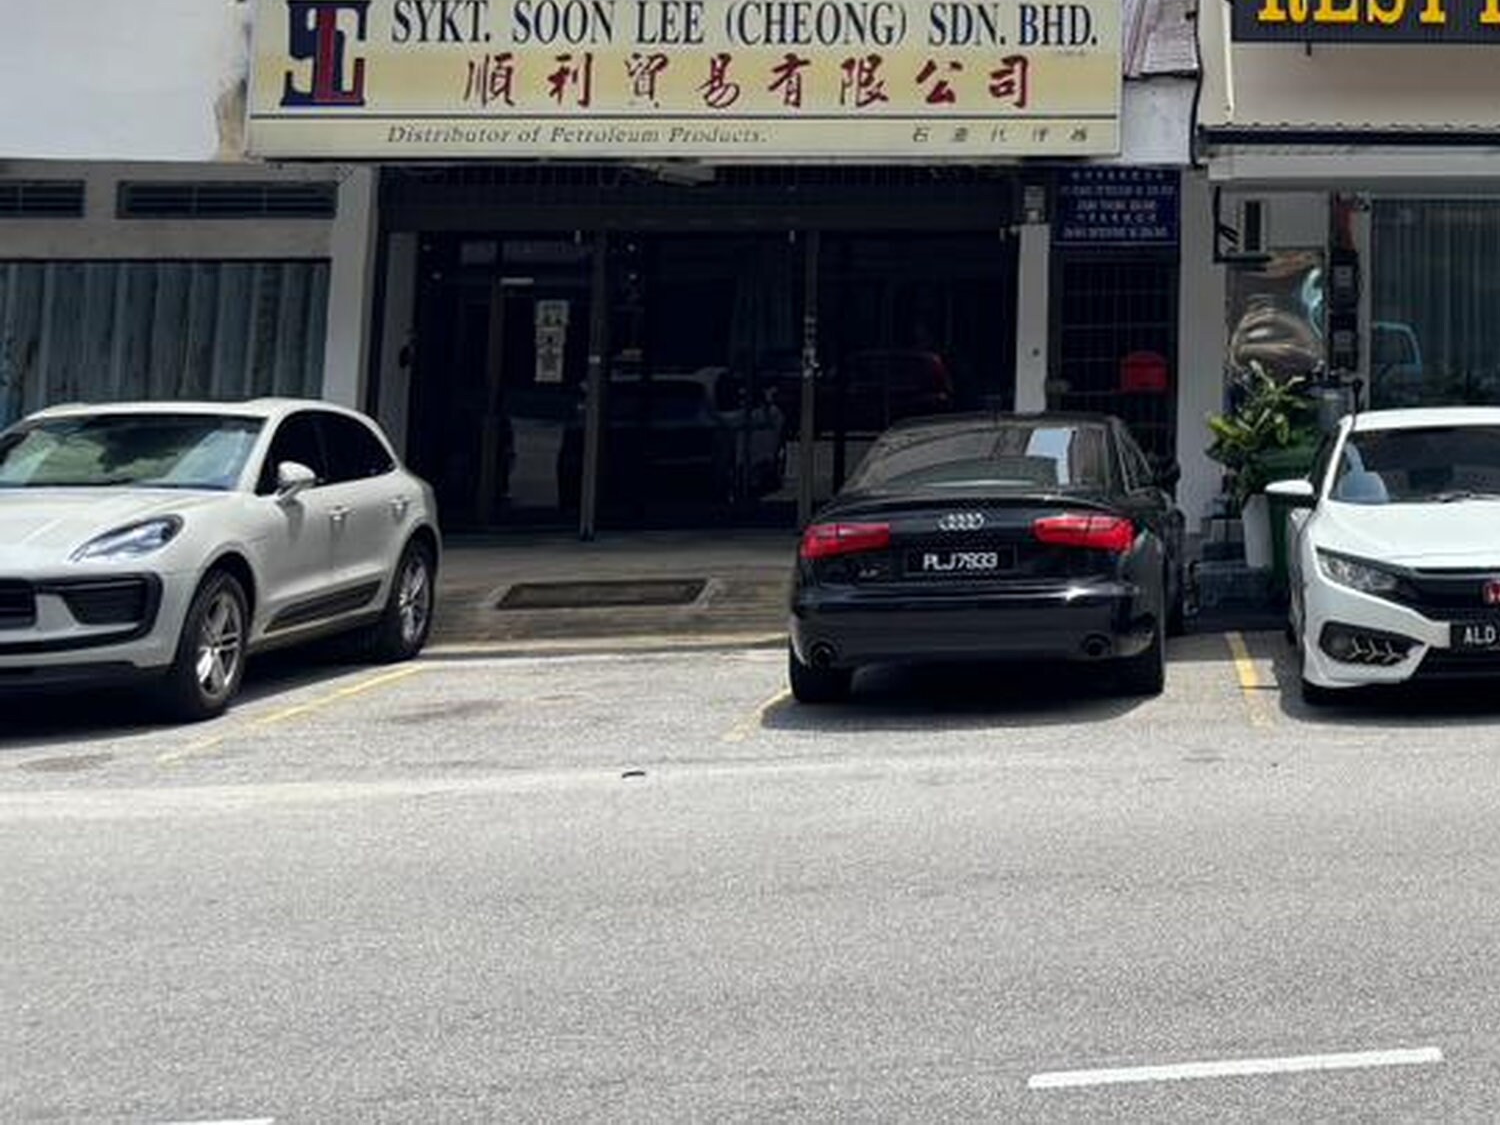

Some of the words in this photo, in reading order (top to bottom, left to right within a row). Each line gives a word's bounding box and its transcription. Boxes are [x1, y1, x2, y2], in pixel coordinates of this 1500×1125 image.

[636, 0, 705, 44] LEE
[727, 0, 907, 46] (CHEONG)
[928, 2, 1006, 46] SDN.
[1019, 4, 1097, 46] BHD.
[387, 125, 512, 144] Distributor
[517, 125, 540, 144] of
[549, 126, 660, 144] Petroleum
